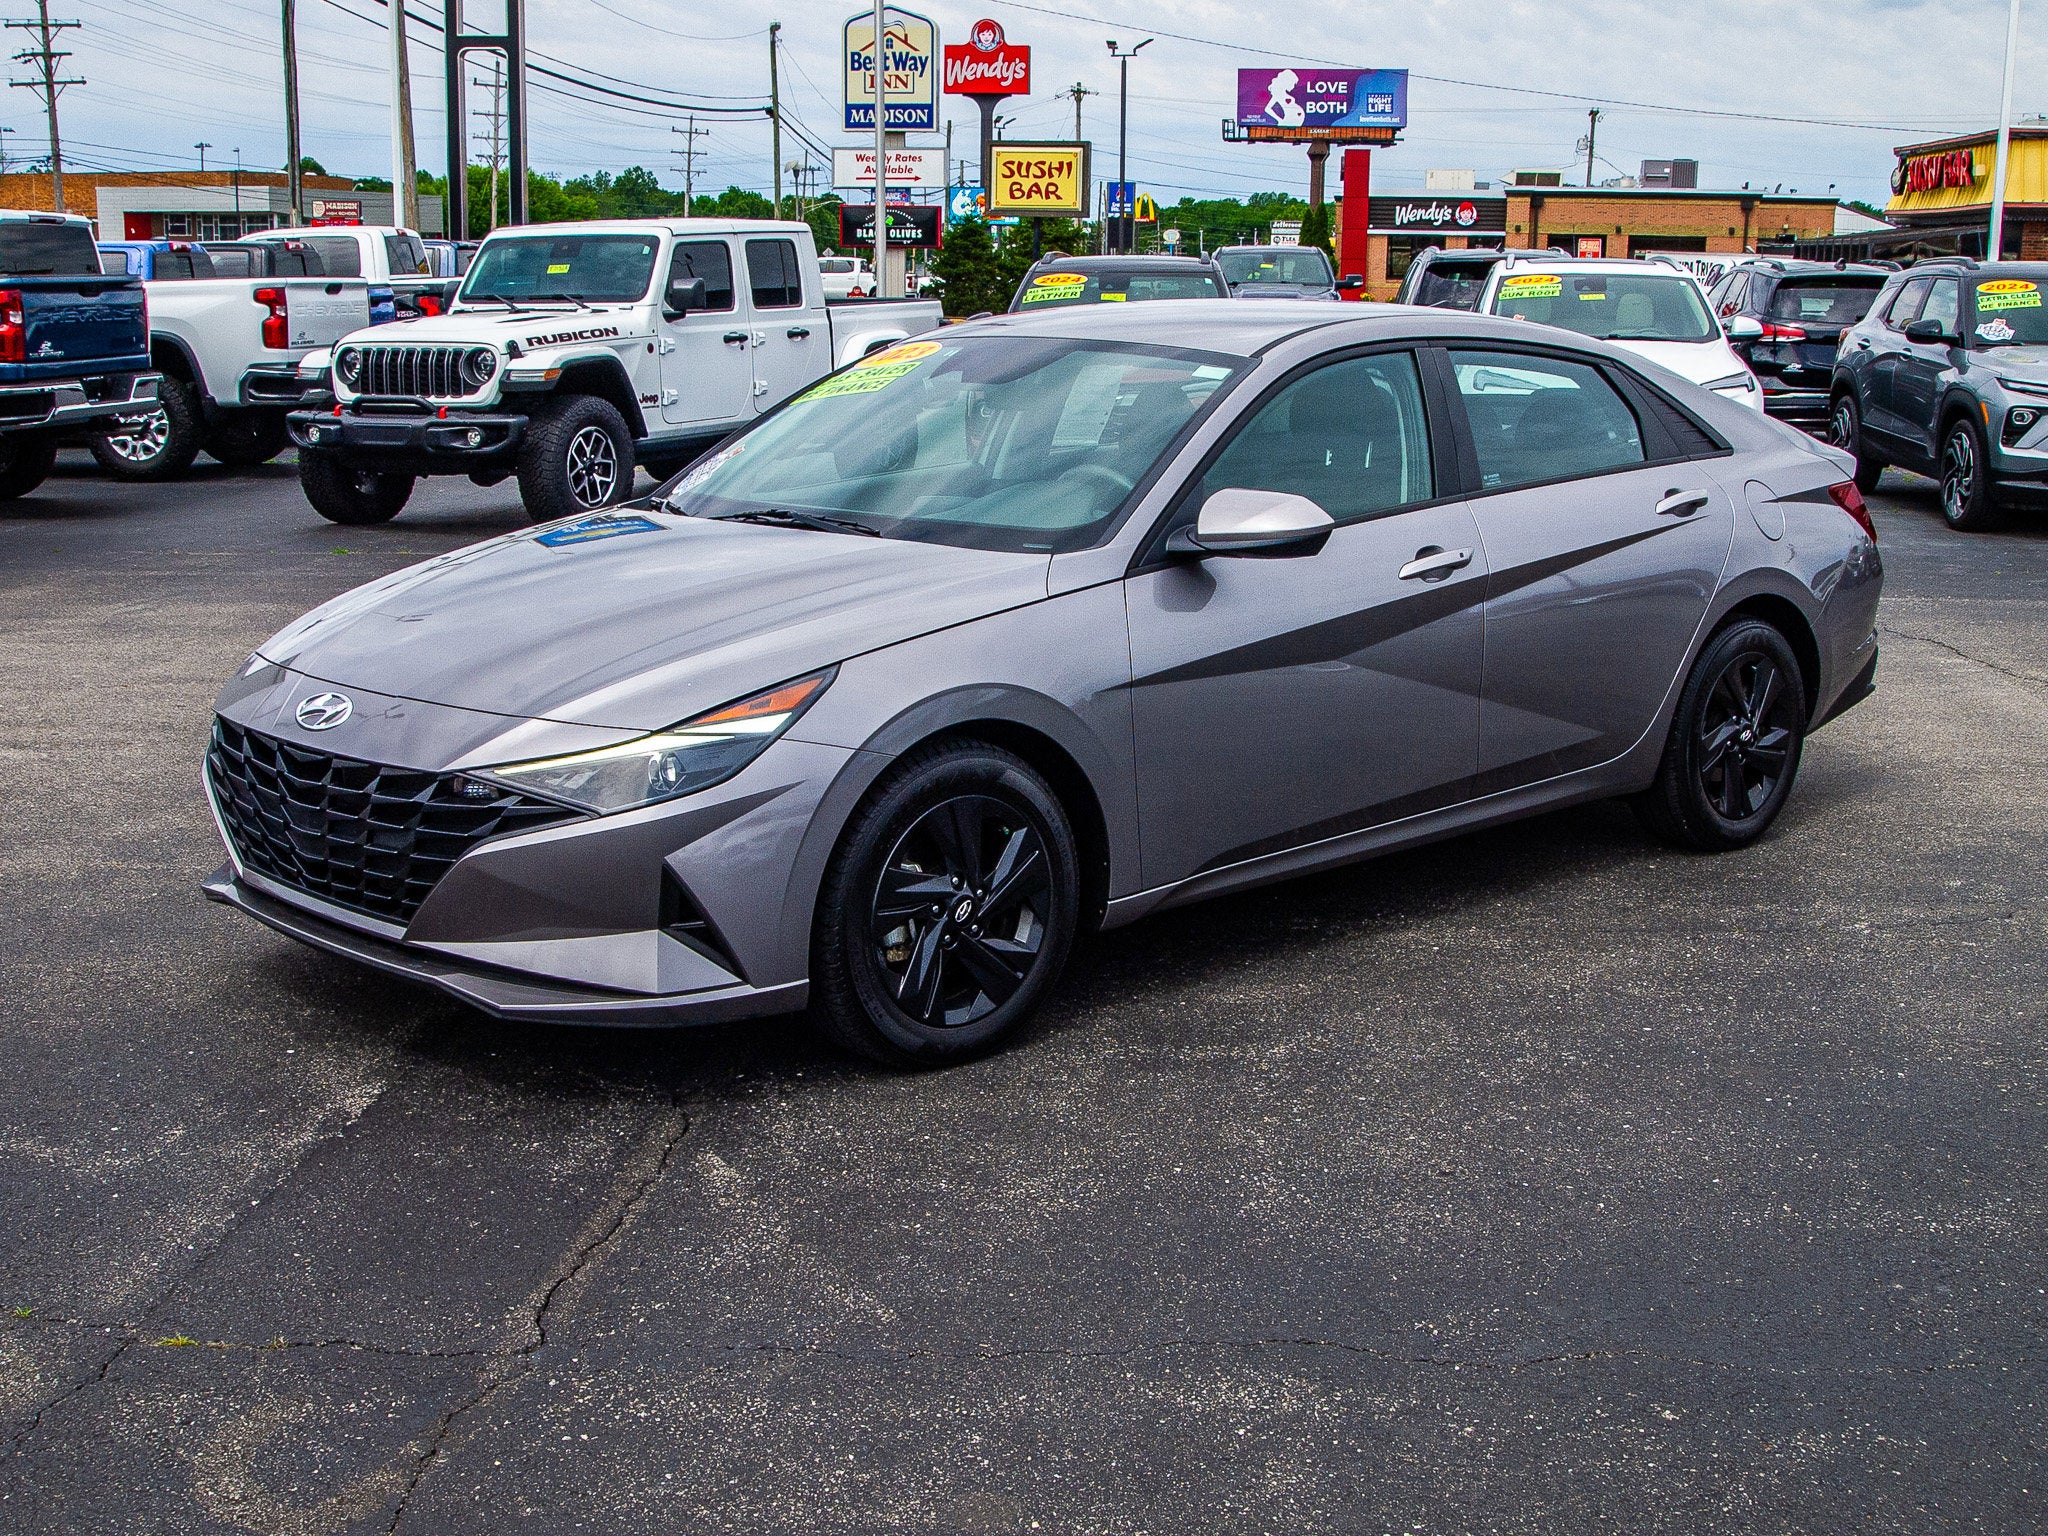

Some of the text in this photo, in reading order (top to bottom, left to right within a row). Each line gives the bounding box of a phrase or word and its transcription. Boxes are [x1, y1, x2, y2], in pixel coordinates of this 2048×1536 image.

[850, 51, 929, 78] Bet Way
[947, 52, 1027, 87] Wendy's
[1306, 81, 1348, 94] LOVE
[1305, 101, 1347, 114] BOTH
[1368, 104, 1392, 112] LIFE
[895, 153, 923, 163] Rates
[864, 164, 914, 174] Avilable
[1001, 160, 1073, 179] SUSHI
[1009, 181, 1063, 200] BAR
[1395, 201, 1453, 226] Wendy's
[889, 228, 923, 239] OLIVES
[1040, 276, 1082, 284] 2024
[1985, 283, 2030, 291] 2024
[1024, 291, 1079, 302] LEATHER
[1528, 289, 1558, 297] ROOF
[1980, 295, 2009, 303] EXTRA
[1997, 300, 2038, 308] FINANCE
[526, 327, 618, 347] RUBICON
[639, 392, 659, 405] Jeep
